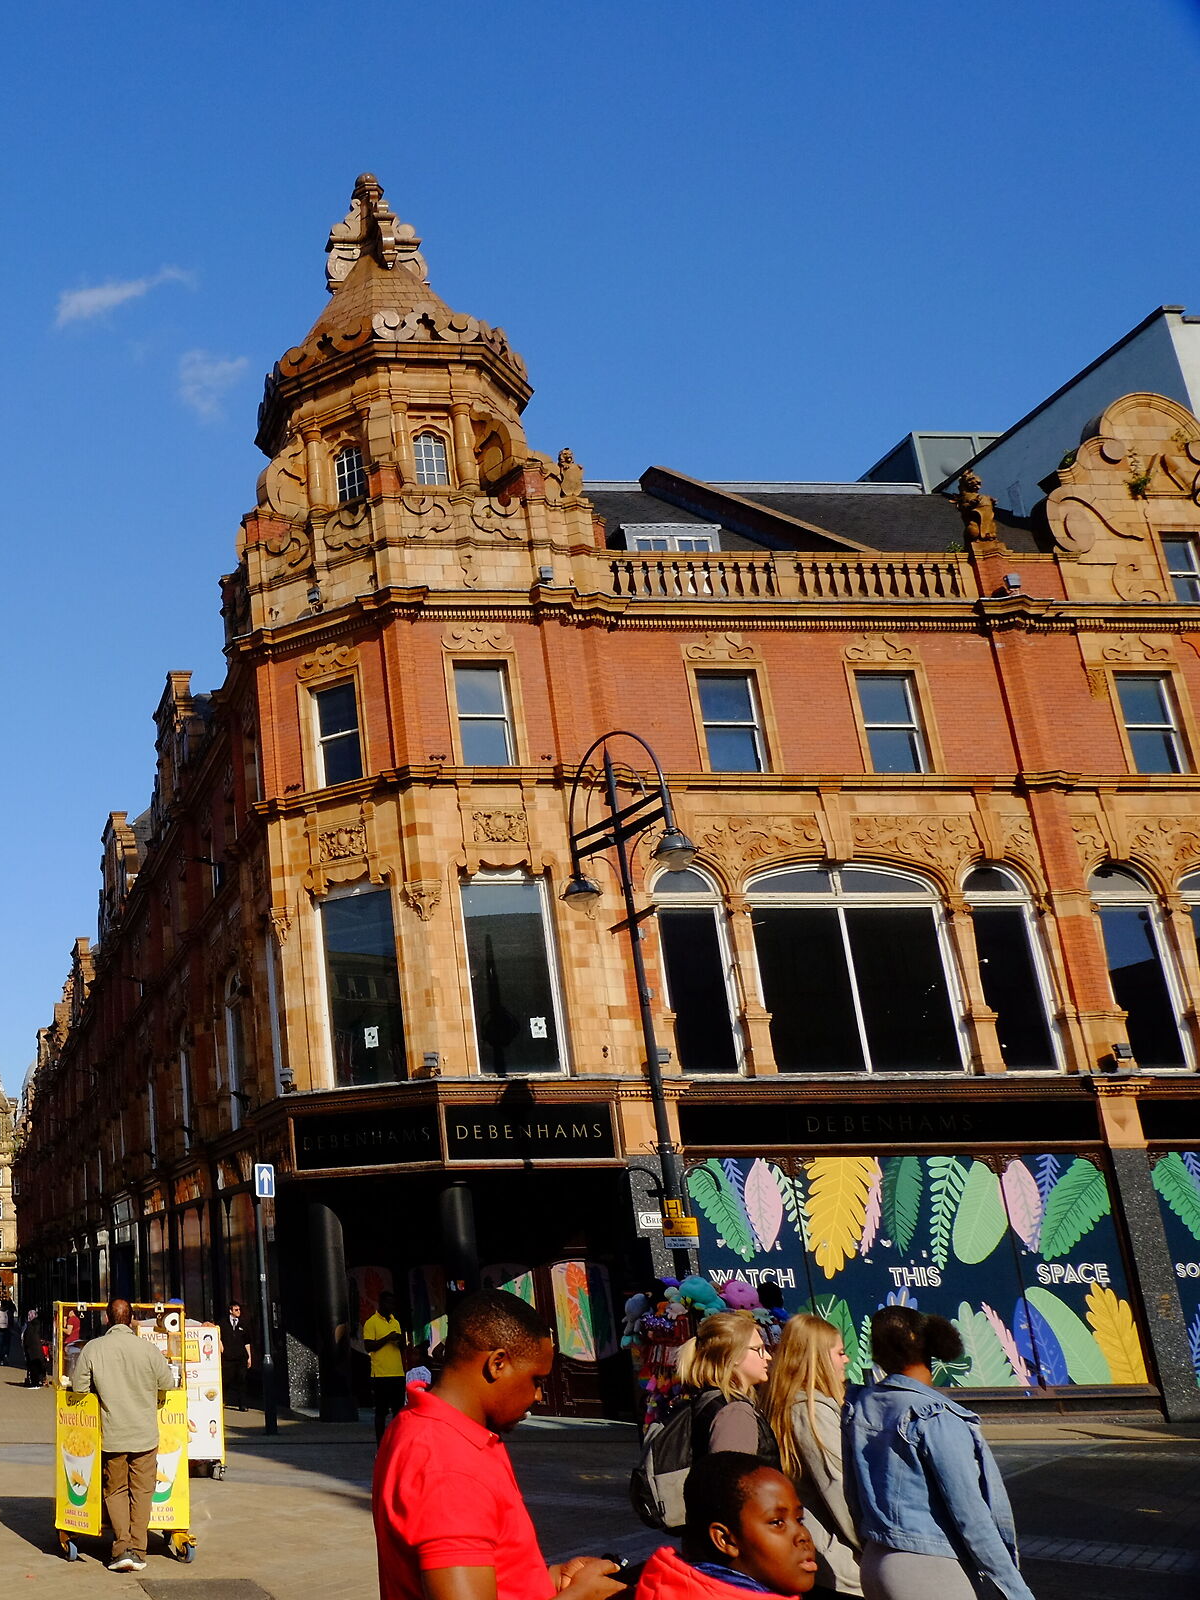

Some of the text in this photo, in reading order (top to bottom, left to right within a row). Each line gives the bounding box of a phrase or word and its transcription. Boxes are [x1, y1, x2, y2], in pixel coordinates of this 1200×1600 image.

[455, 1122, 603, 1141] DEBENHAMS
[806, 1113, 973, 1133] DEBENHAMS
[302, 1126, 431, 1152] DEBENHAMS
[708, 1268, 796, 1289] WATCH
[888, 1266, 942, 1288] THIS
[1036, 1262, 1112, 1285] SPACE
[67, 1395, 88, 1409] Super
[59, 1408, 97, 1428] Sweet Corn
[160, 1408, 185, 1425] Corn
